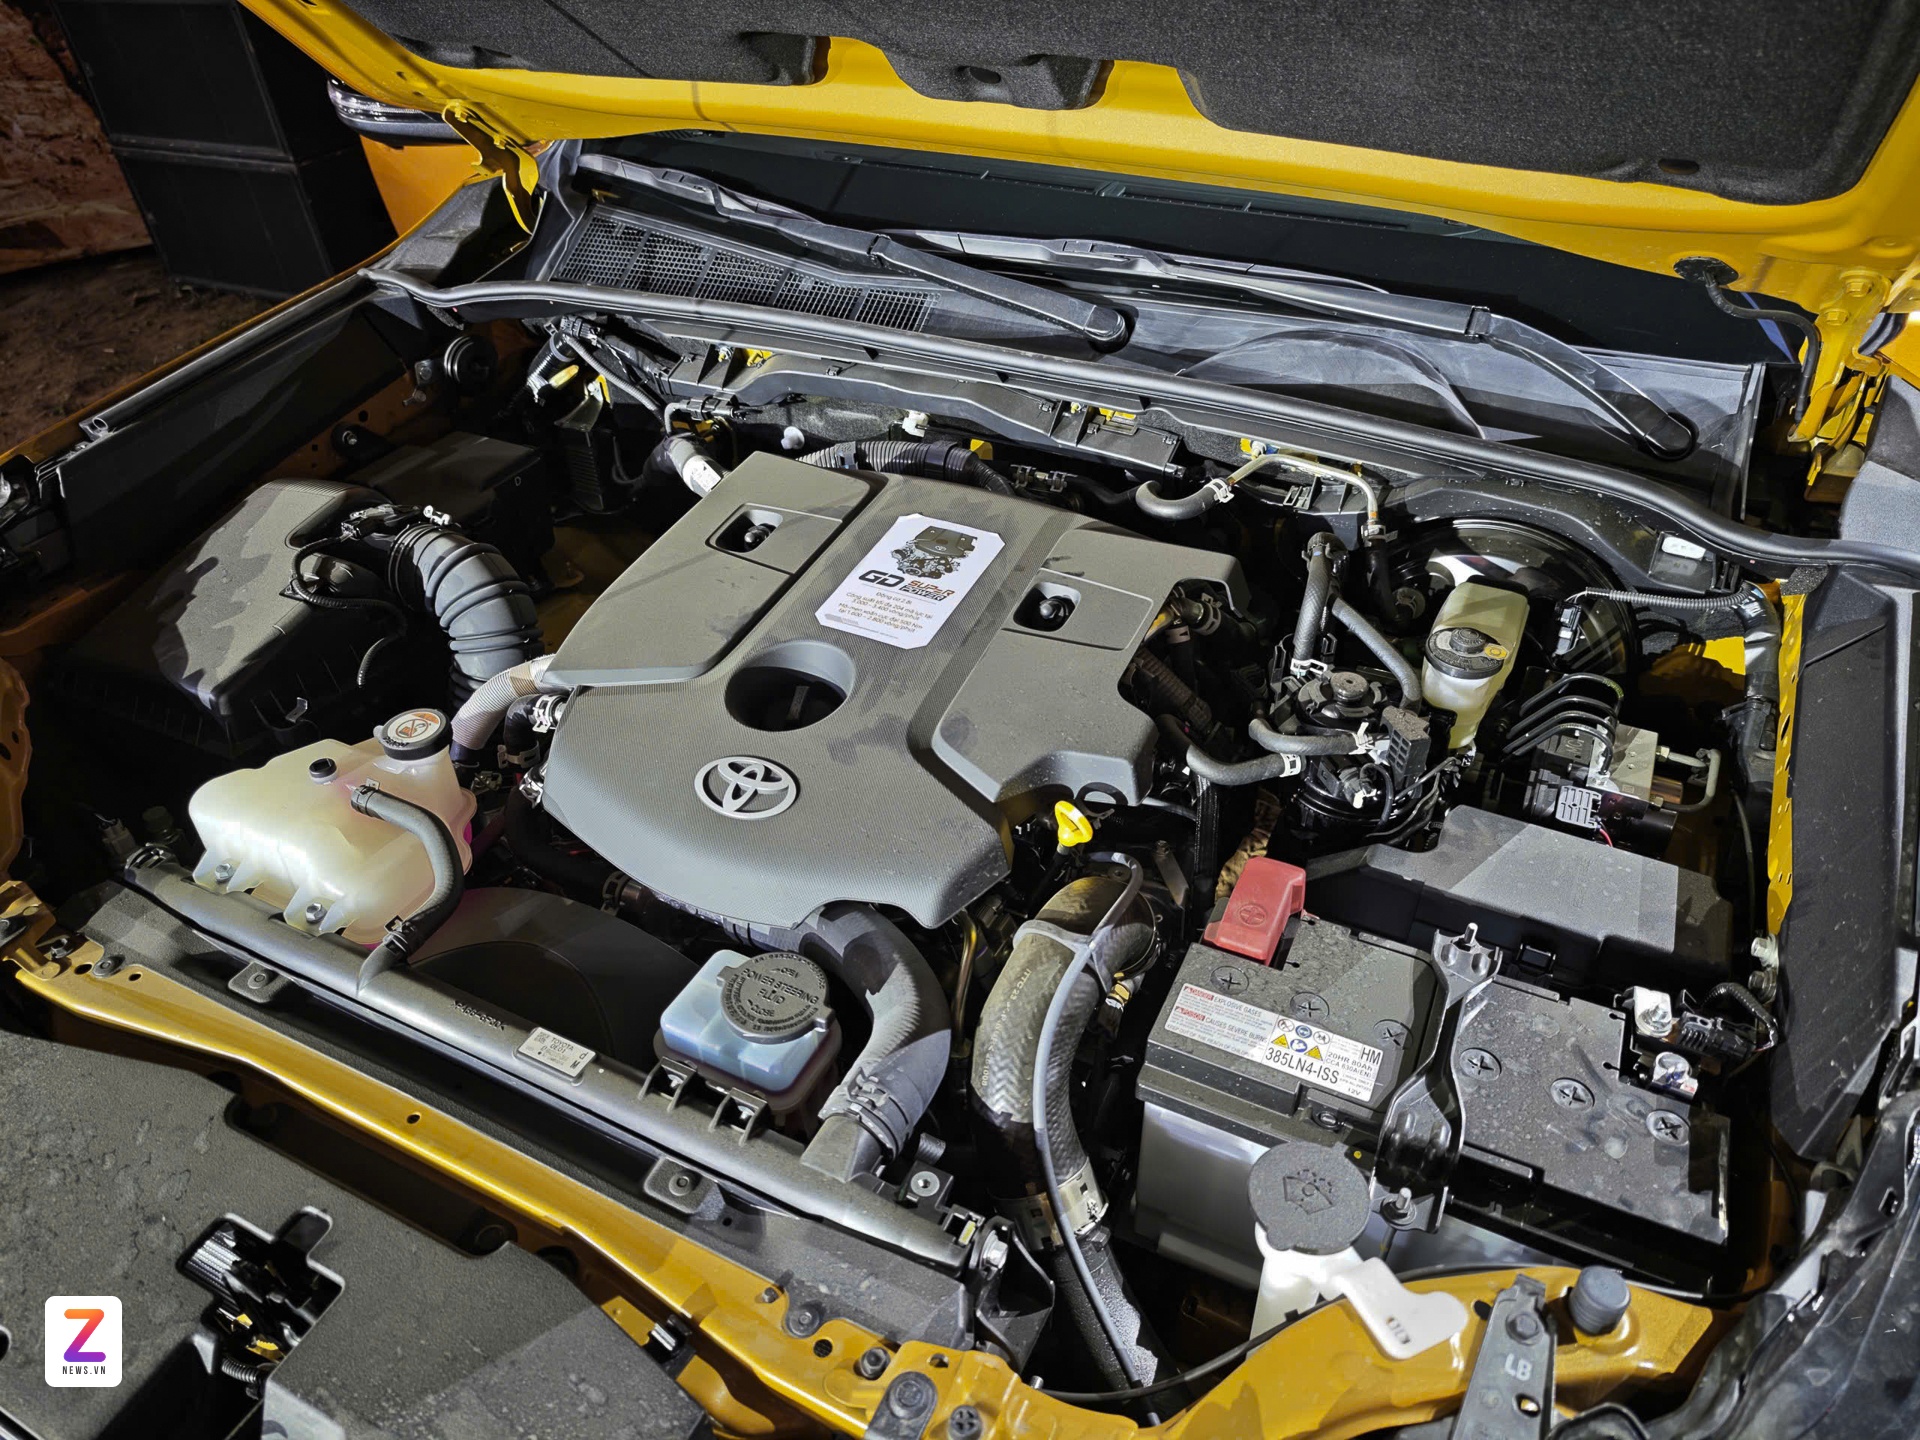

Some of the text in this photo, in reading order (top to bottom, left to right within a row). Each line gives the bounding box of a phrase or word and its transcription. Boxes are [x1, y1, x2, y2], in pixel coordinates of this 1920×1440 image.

[859, 570, 955, 596] GD SUPER
[899, 585, 947, 601] POWER
[893, 603, 904, 611] 204
[741, 968, 775, 986] POWER
[774, 981, 819, 1004] STEERING
[757, 988, 785, 1004] FLUID
[750, 1004, 775, 1017] CLOSE
[1214, 996, 1243, 1011] EXPLOSIVE
[1243, 1006, 1262, 1018] GASES
[1205, 1017, 1227, 1029] CAUSES
[1228, 1025, 1248, 1036] SEVERE
[550, 1037, 574, 1051] TOYOTA
[1265, 1047, 1340, 1084] 385LN4-ISS
[1326, 1058, 1340, 1067] CCA
[1328, 1051, 1373, 1072] 20HR 80Ah
[1361, 1047, 1381, 1066] HM
[1348, 1087, 1361, 1096] 12V
[1504, 1353, 1532, 1381] LB
